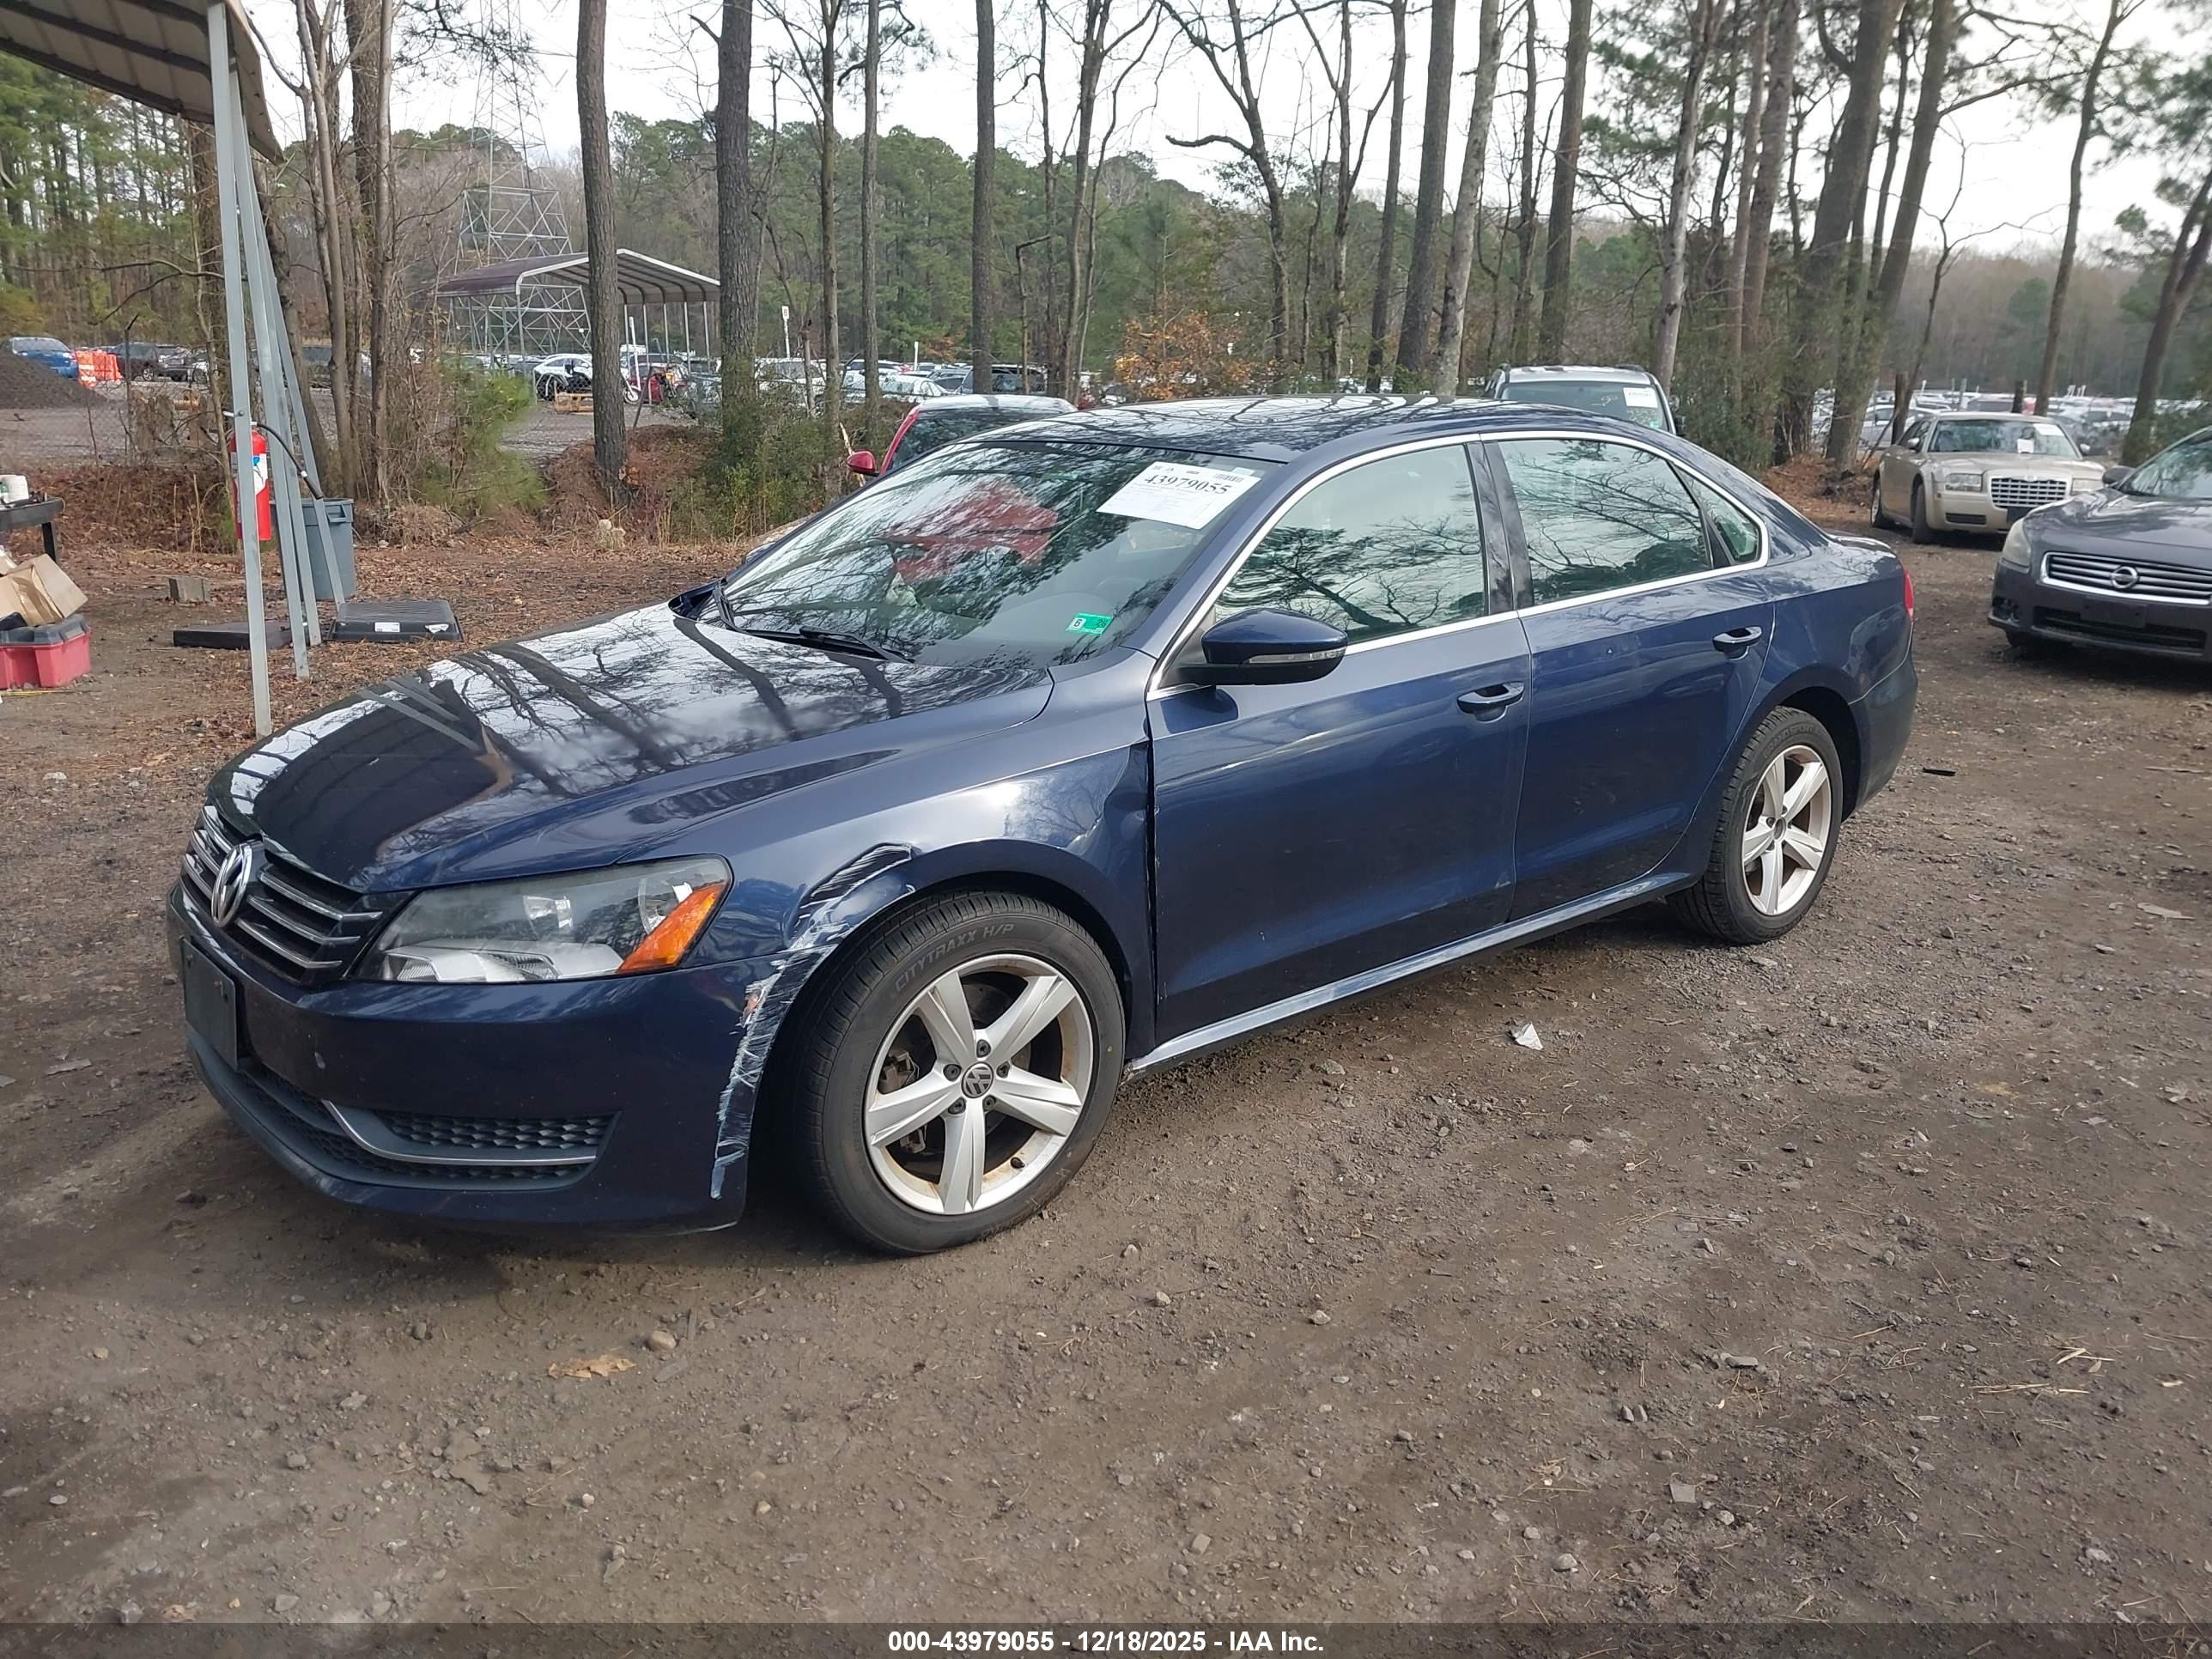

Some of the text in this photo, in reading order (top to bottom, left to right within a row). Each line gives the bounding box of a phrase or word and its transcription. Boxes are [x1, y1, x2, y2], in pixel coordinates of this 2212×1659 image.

[1144, 474, 1231, 495] 43979055
[894, 923, 1015, 991] CITYTRAXX H/P
